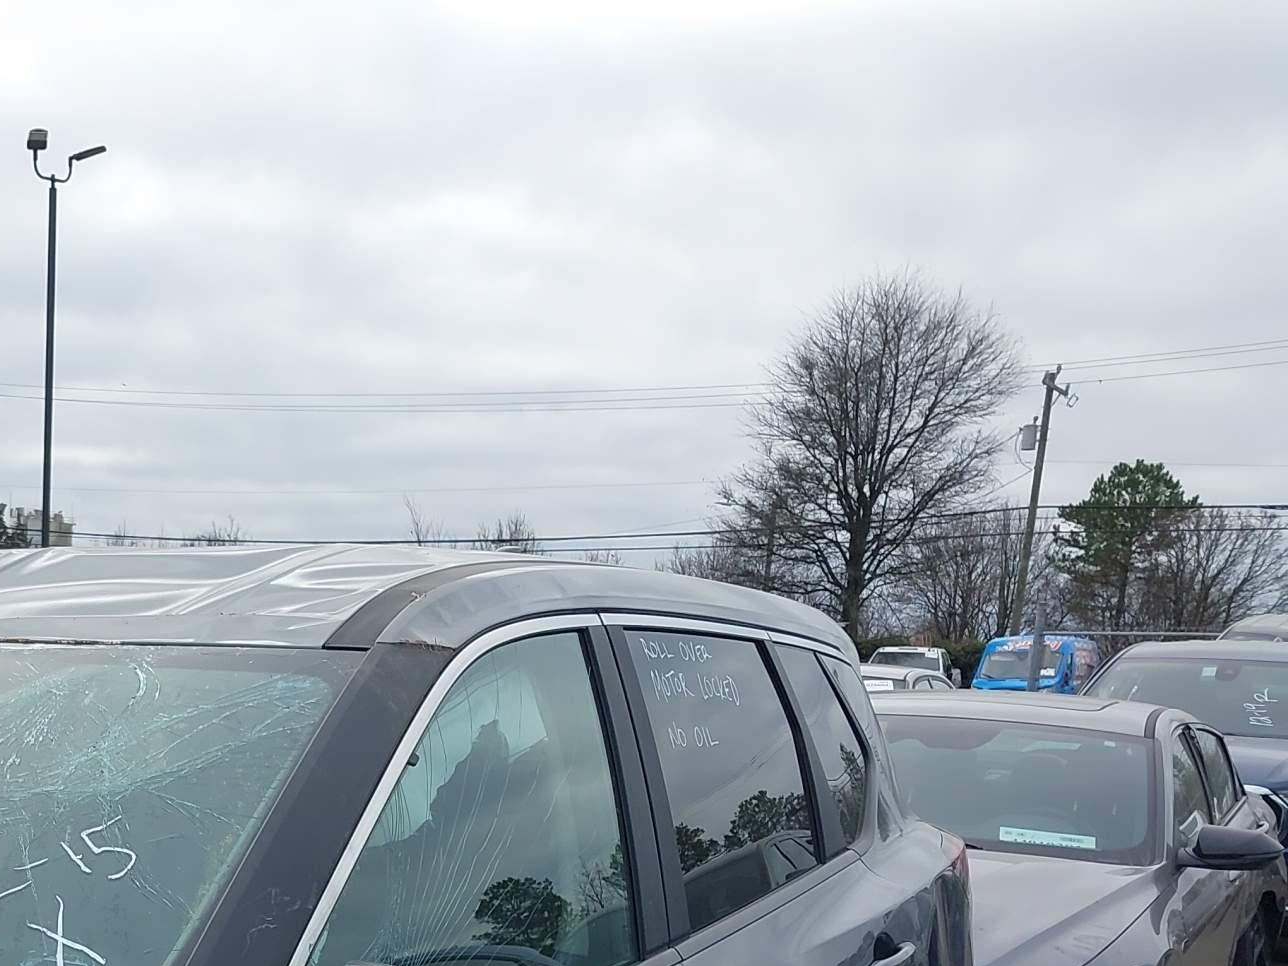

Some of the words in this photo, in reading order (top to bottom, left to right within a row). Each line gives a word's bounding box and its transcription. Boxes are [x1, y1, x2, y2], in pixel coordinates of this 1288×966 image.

[639, 638, 675, 660] ROLL
[678, 641, 712, 662] OVER
[650, 669, 695, 703] MOTOR
[697, 672, 740, 706] LOCKED
[668, 720, 688, 749] NO
[694, 725, 720, 748] OIL
